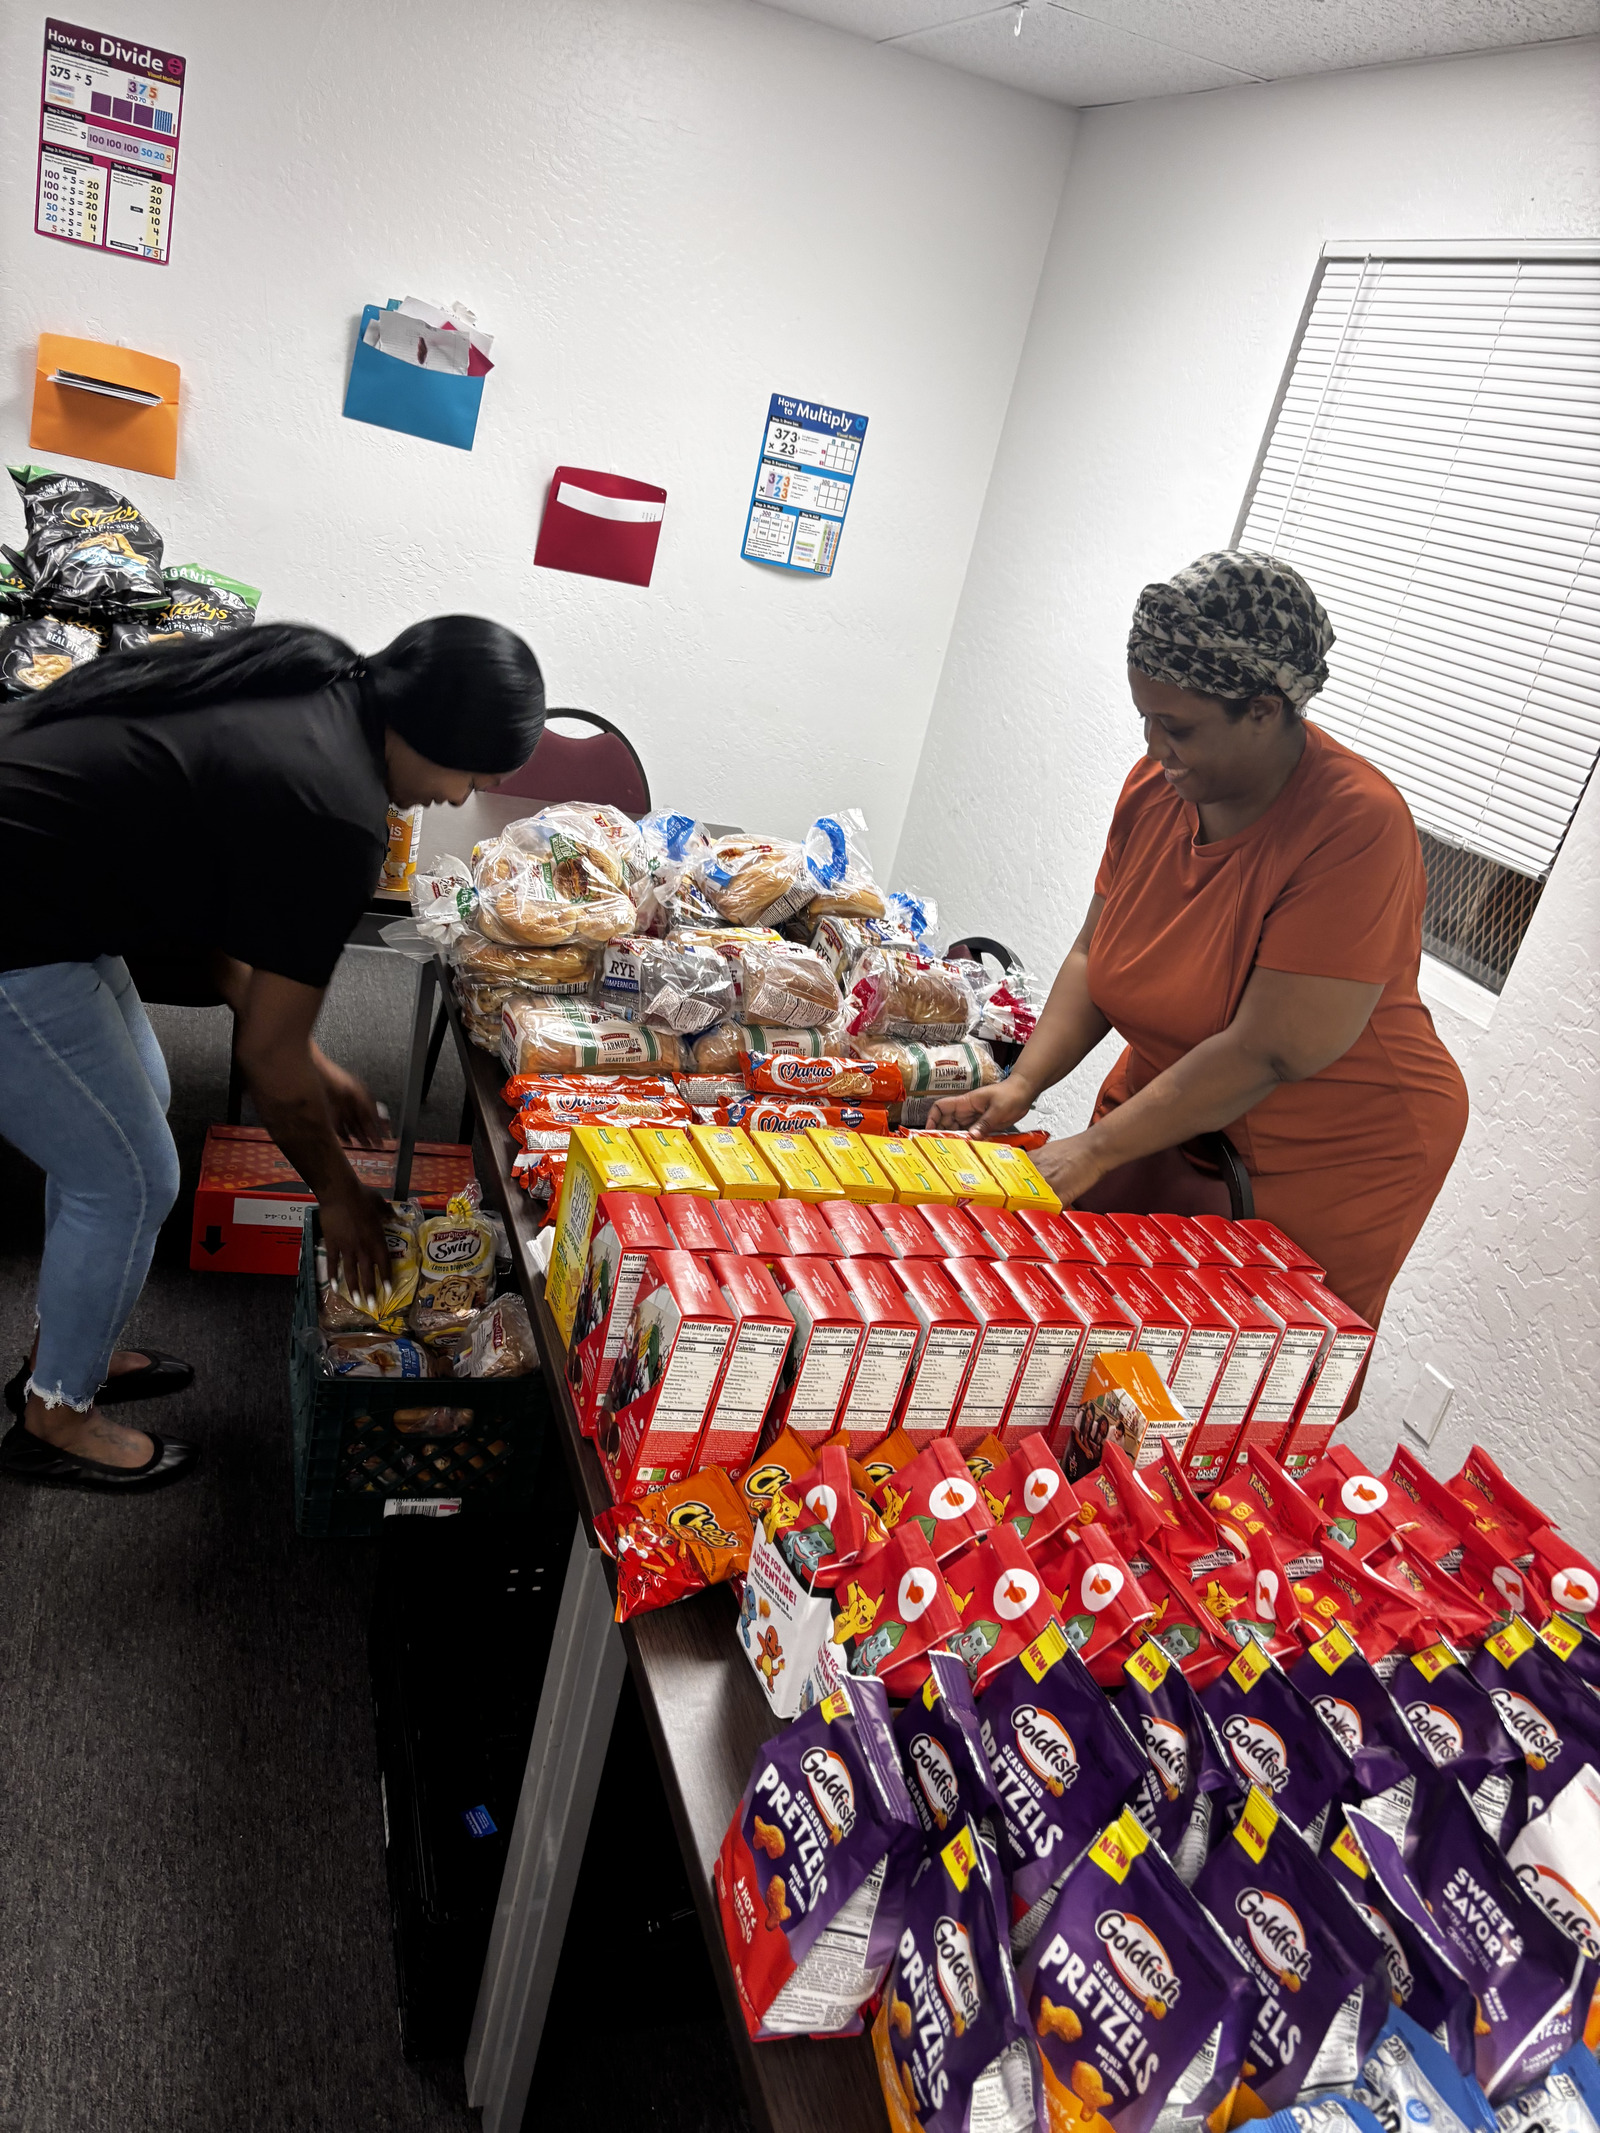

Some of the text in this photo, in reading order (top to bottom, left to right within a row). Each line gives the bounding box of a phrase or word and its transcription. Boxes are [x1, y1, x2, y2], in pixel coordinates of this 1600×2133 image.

[48, 29, 77, 47] How
[81, 40, 95, 52] to
[100, 37, 164, 72] Divide
[50, 65, 71, 80] 375
[85, 74, 92, 86] 5
[80, 131, 87, 140] 5
[89, 134, 104, 145] 100
[106, 137, 122, 148] 100
[124, 143, 139, 154] 100
[141, 147, 153, 157] 50
[154, 150, 165, 161] 20
[44, 180, 98, 200] 100 5 20
[45, 169, 99, 190] 100 5 20
[150, 185, 163, 195] 20
[43, 191, 98, 211] 100 5 20
[46, 202, 98, 222] 50 5 10
[149, 206, 161, 215] 20
[150, 195, 162, 205] 20
[45, 213, 97, 232] 20 5 4
[51, 225, 96, 242] 5 5 1
[151, 217, 160, 226] 10
[153, 227, 159, 236] 4
[778, 397, 797, 409] How
[784, 403, 853, 432] to Multiply
[775, 428, 798, 443] 373
[780, 442, 796, 455] 23
[161, 567, 216, 586] RGANIC
[46, 632, 65, 646] REAL
[609, 960, 636, 978] RYE
[602, 1038, 639, 1051] FARMHOUSE
[780, 1063, 833, 1080] Marias
[935, 1067, 967, 1078] FARMHOUSE
[760, 1116, 817, 1133] Marias
[435, 1239, 475, 1260] Swirl
[681, 1322, 731, 1333] Nutrition Facts
[742, 1323, 791, 1334] Nutrition Facts
[814, 1327, 841, 1335] Nutrition
[871, 1328, 898, 1336] Nutrition
[932, 1328, 976, 1337] Nutrition Facts
[987, 1327, 1013, 1335] Nutrition
[1039, 1328, 1064, 1336] Nutrition
[1143, 1327, 1167, 1335] Nutrition
[667, 1500, 738, 1548] Cheetos
[759, 1544, 790, 1583] TIME FOR AN
[752, 1549, 797, 1606] ADVENTURE!
[1318, 1638, 1342, 1664] NEW
[1495, 1634, 1517, 1659] NEW
[1543, 1631, 1573, 1652] NEW
[1027, 1643, 1048, 1672] NEW
[1135, 1653, 1163, 1682] NEW
[1236, 1654, 1258, 1681] NEW
[1421, 1651, 1442, 1672] NEW
[1011, 1705, 1080, 1788] Goldfish
[1222, 1714, 1291, 1793] Goldfish
[910, 1734, 959, 1819] Goldfish
[1002, 1744, 1044, 1799] SEASONED
[801, 1748, 856, 1837] Goldfish
[906, 1776, 933, 1832] SEASONED
[795, 1790, 829, 1849] SEASONED
[755, 1763, 828, 1912] PRETZELS
[1241, 1818, 1265, 1849] NEW
[1341, 1833, 1362, 1857] NE
[950, 1840, 969, 1877] NEW
[1098, 1837, 1129, 1870] NEW
[741, 1889, 754, 1914] HOT
[1454, 1867, 1524, 1956] SWEET &
[1235, 1887, 1312, 1982] Goldfish
[1442, 1881, 1517, 1967] SAVORY
[1442, 1901, 1460, 1929] WITH
[1466, 1933, 1492, 1973] PRETZEL
[1446, 1927, 1477, 1967] CRUNCH
[1095, 1910, 1181, 2009] Goldfish
[934, 1916, 981, 2029] Goldfish
[927, 1964, 951, 2037] SEASONED
[1092, 1960, 1144, 2024] SEASONED
[900, 1927, 950, 2111] PRETZELS
[1038, 1933, 1160, 2096] PRETZELS
[1100, 2059, 1130, 2097] FLAVORED
